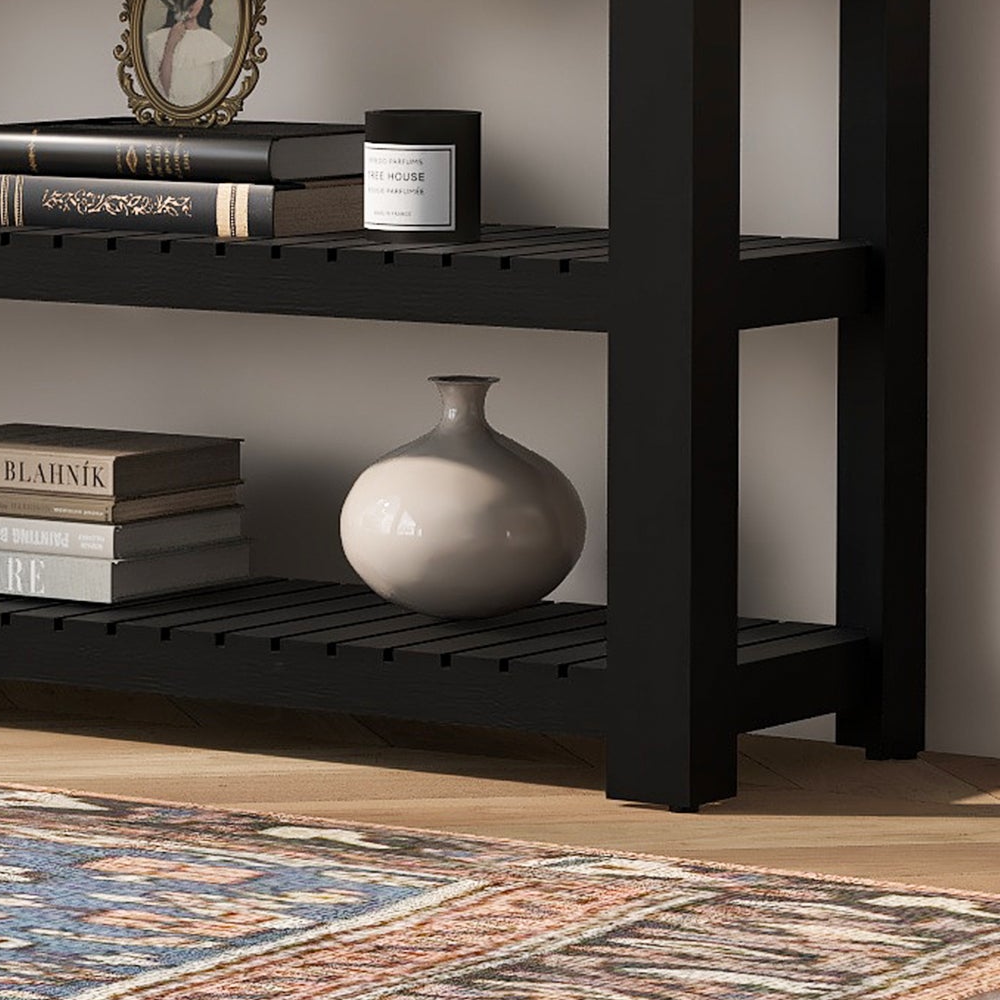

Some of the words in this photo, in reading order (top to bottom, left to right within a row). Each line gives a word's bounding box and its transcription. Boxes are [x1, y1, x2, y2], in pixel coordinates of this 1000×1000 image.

[387, 172, 425, 182] HOUSE
[4, 459, 106, 489] BLAHNÍK
[12, 527, 70, 549] PAINTING
